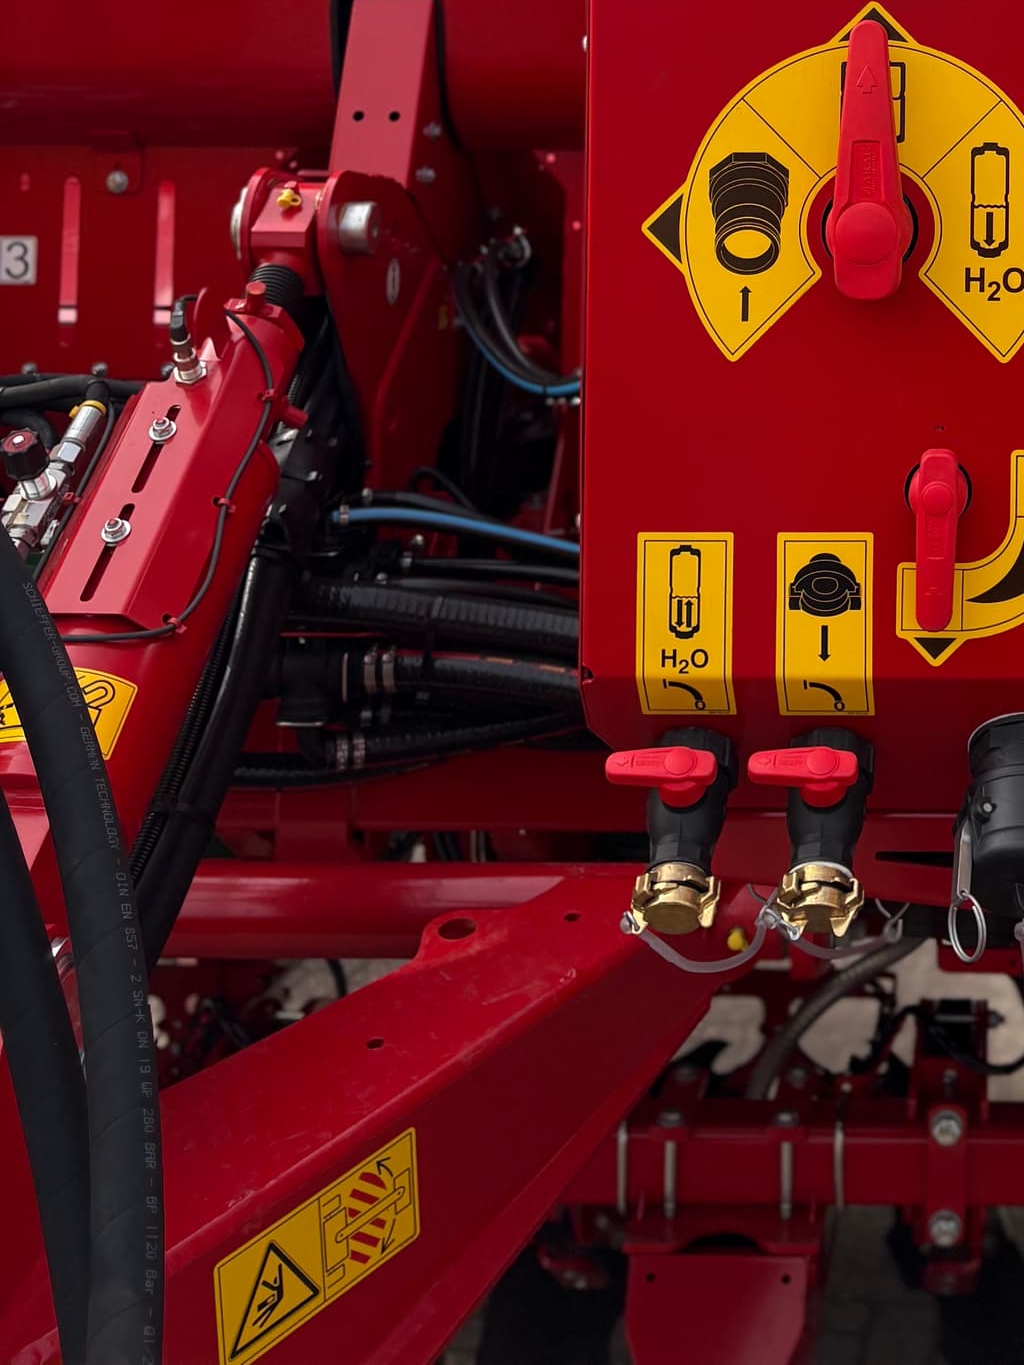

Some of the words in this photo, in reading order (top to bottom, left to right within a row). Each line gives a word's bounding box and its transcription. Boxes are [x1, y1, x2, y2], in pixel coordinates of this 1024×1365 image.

[5, 241, 30, 280] 3
[80, 726, 101, 770] GERMAN
[95, 778, 121, 850] TECHNOLOGY
[115, 872, 129, 897] DIN
[121, 903, 133, 920] EN
[125, 927, 139, 950] 857
[130, 974, 142, 984] 2
[137, 1031, 150, 1049] DN
[139, 1058, 152, 1074] 19
[141, 1081, 153, 1098] WP
[142, 1107, 155, 1133] 280
[144, 1142, 157, 1170] BAR
[145, 1196, 158, 1214] BP
[145, 1226, 158, 1259] 1120
[144, 1269, 158, 1297] Bar
